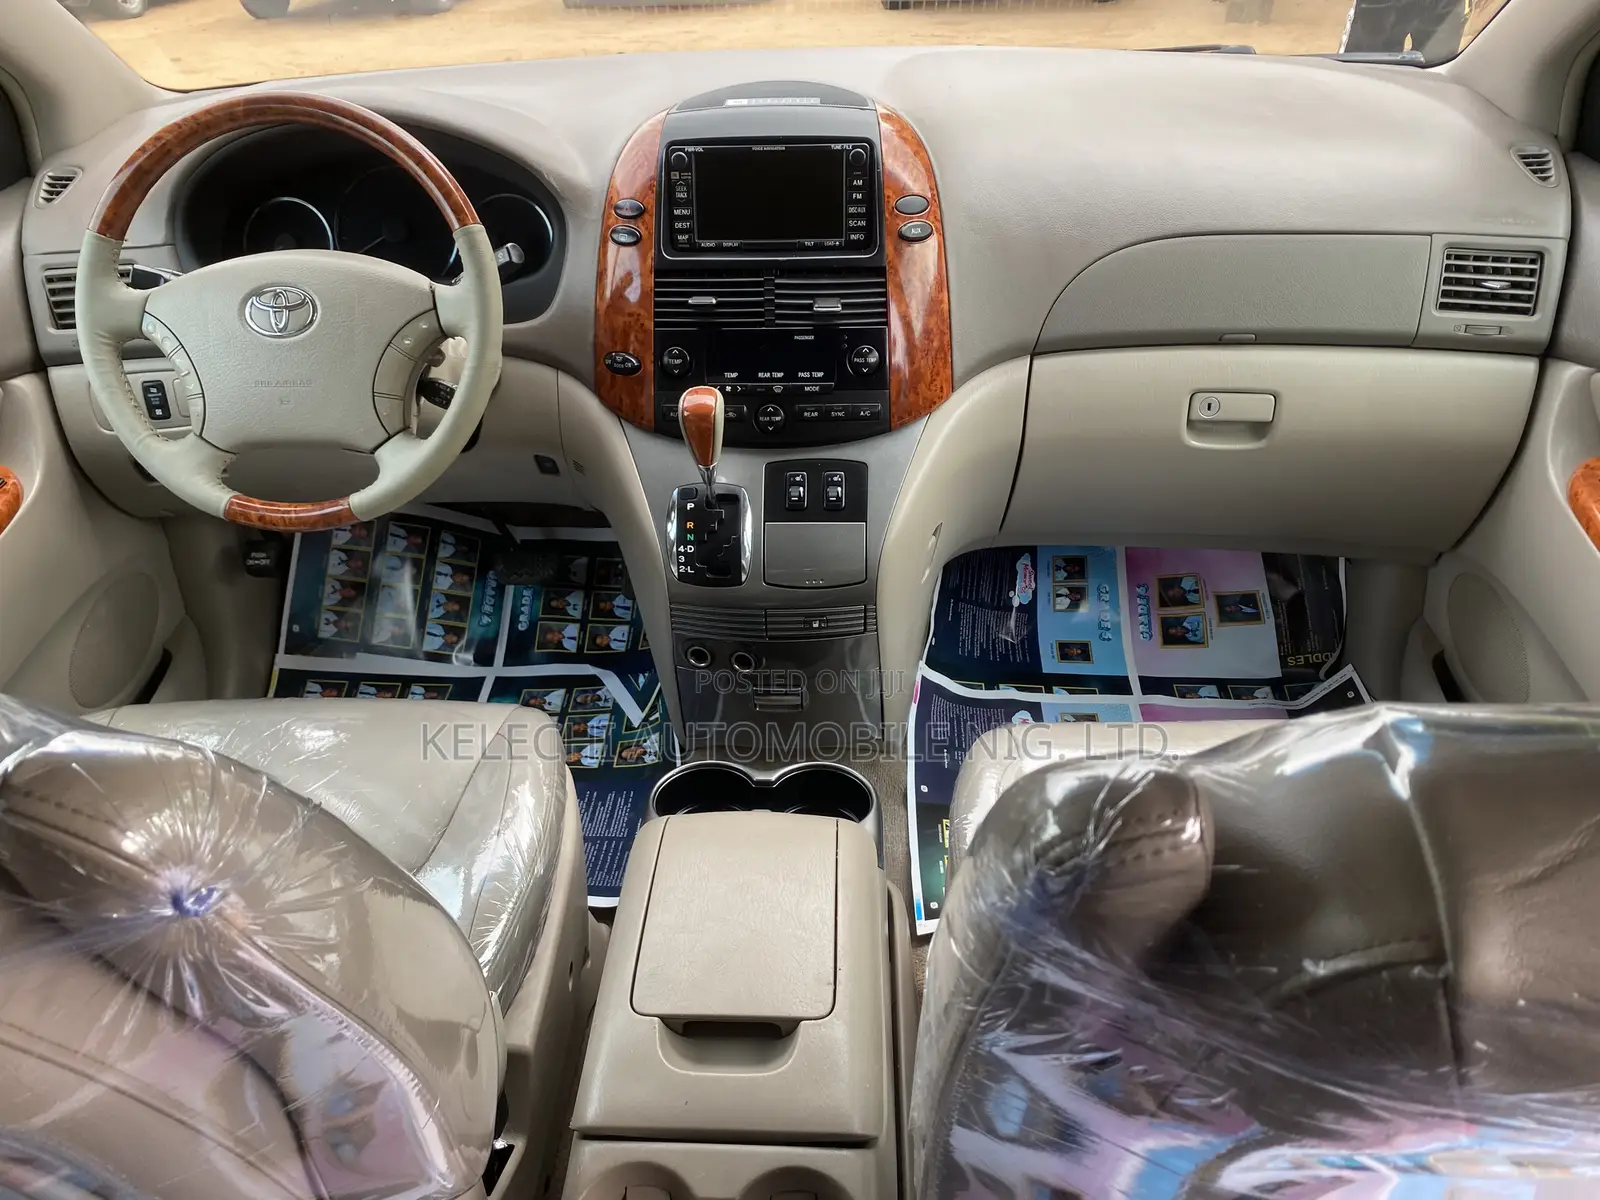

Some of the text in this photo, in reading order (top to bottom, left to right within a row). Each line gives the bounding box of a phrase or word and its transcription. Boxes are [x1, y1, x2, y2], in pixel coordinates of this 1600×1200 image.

[686, 502, 695, 511] P
[686, 521, 695, 529] R
[686, 533, 695, 541] N
[678, 555, 685, 563] 3
[481, 570, 498, 614] GRADE
[1096, 583, 1111, 631] GRADE
[1136, 595, 1153, 641] GRADE
[1287, 652, 1334, 666] DDLES
